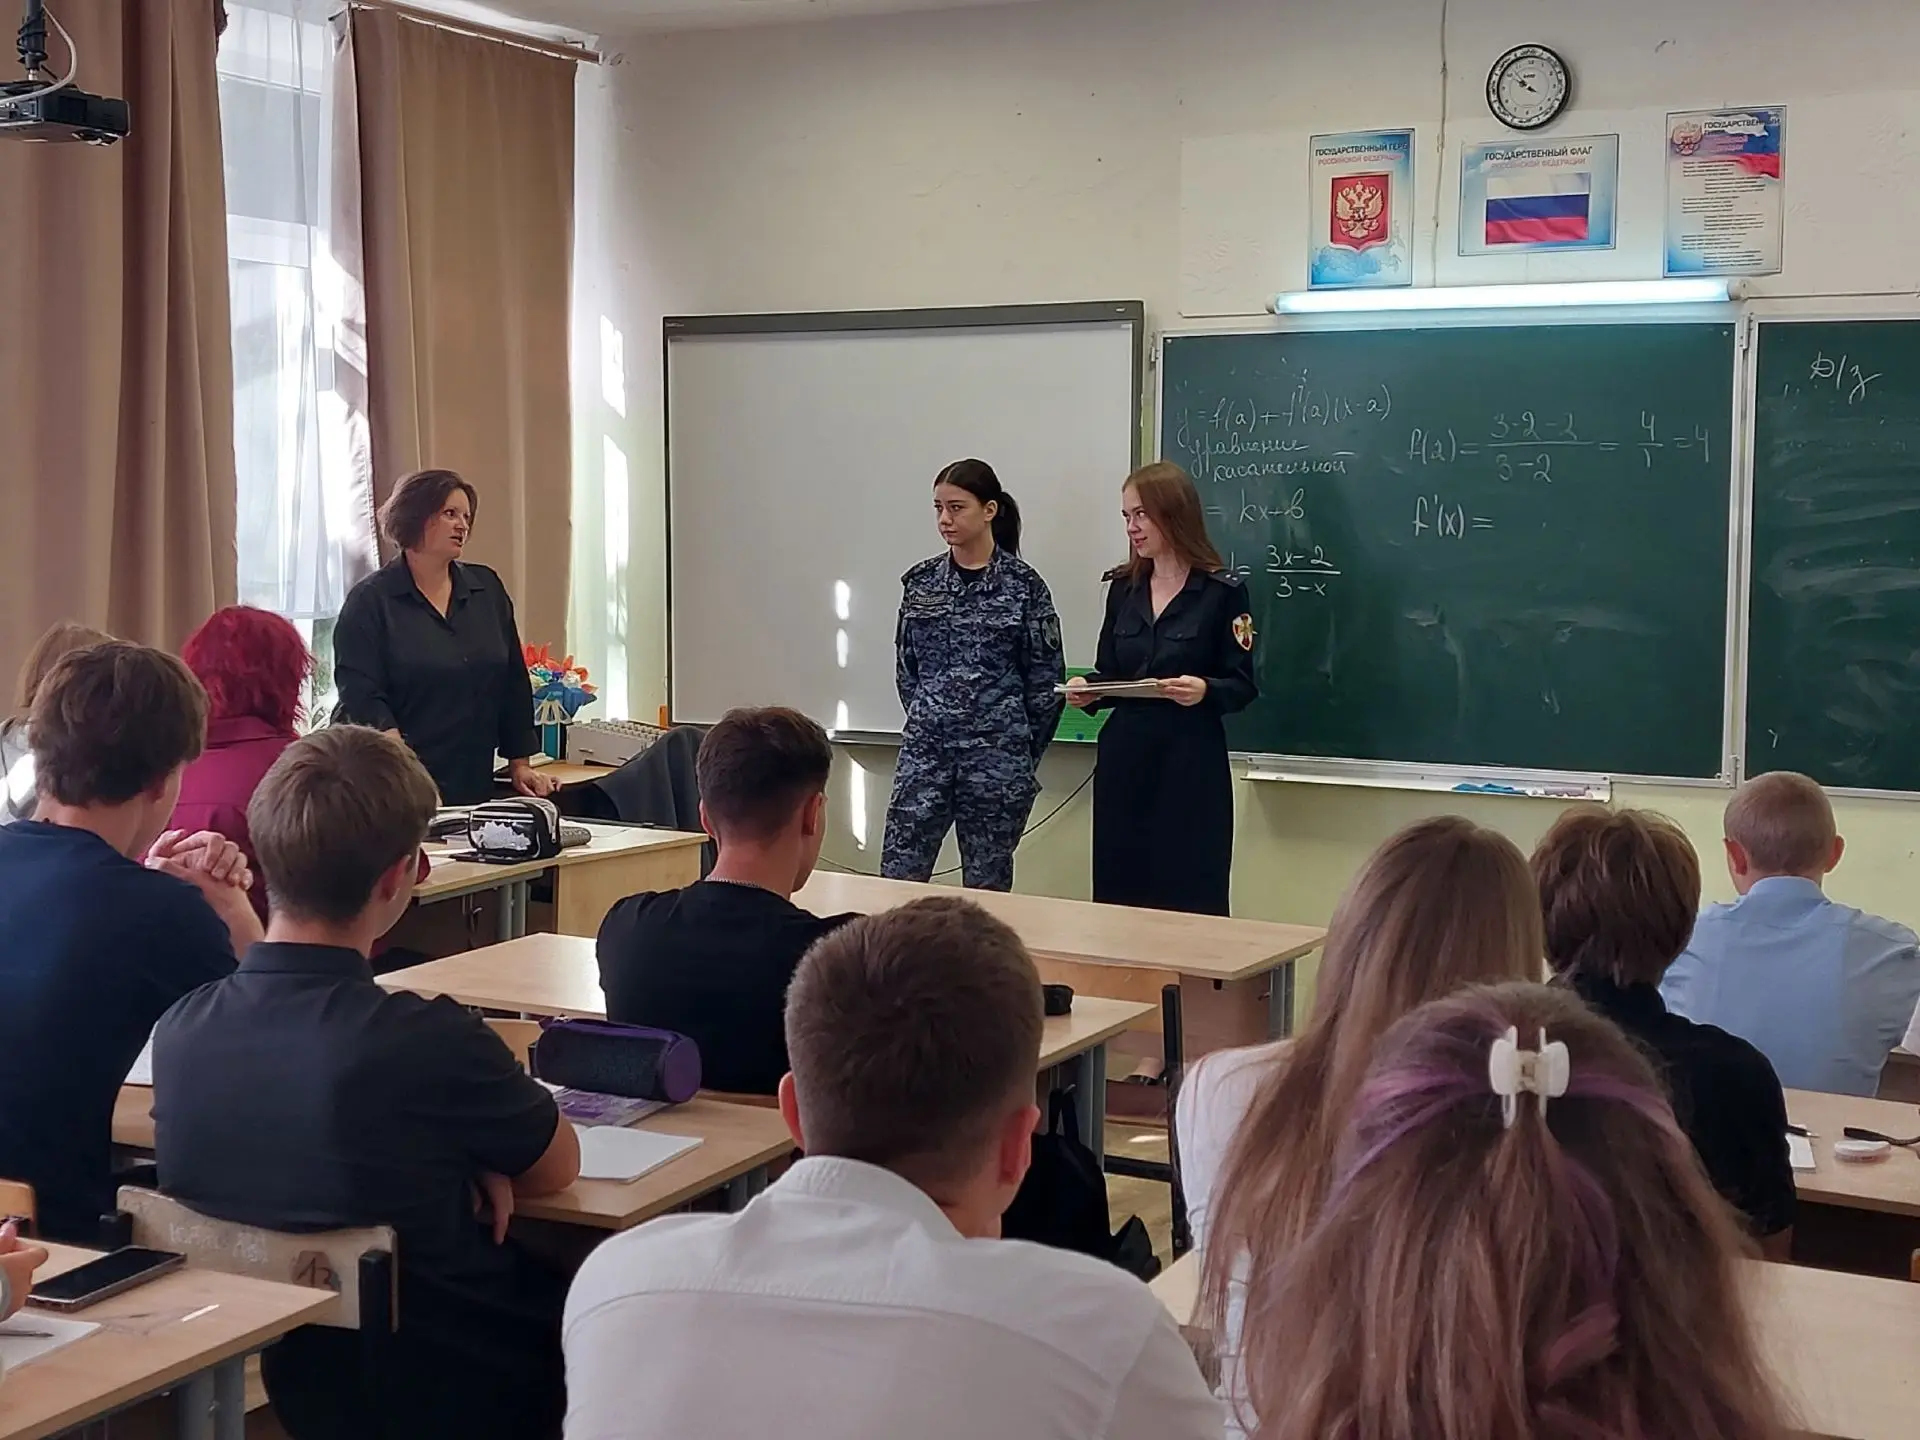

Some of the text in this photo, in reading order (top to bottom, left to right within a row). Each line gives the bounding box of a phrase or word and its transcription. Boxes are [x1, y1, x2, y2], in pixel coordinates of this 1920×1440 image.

[1315, 143, 1388, 157] ГОСУДАРСТВЕННЫЙ
[1484, 146, 1593, 161] ГОСУДАРСТВЕННЫЙ ФЛАГ
